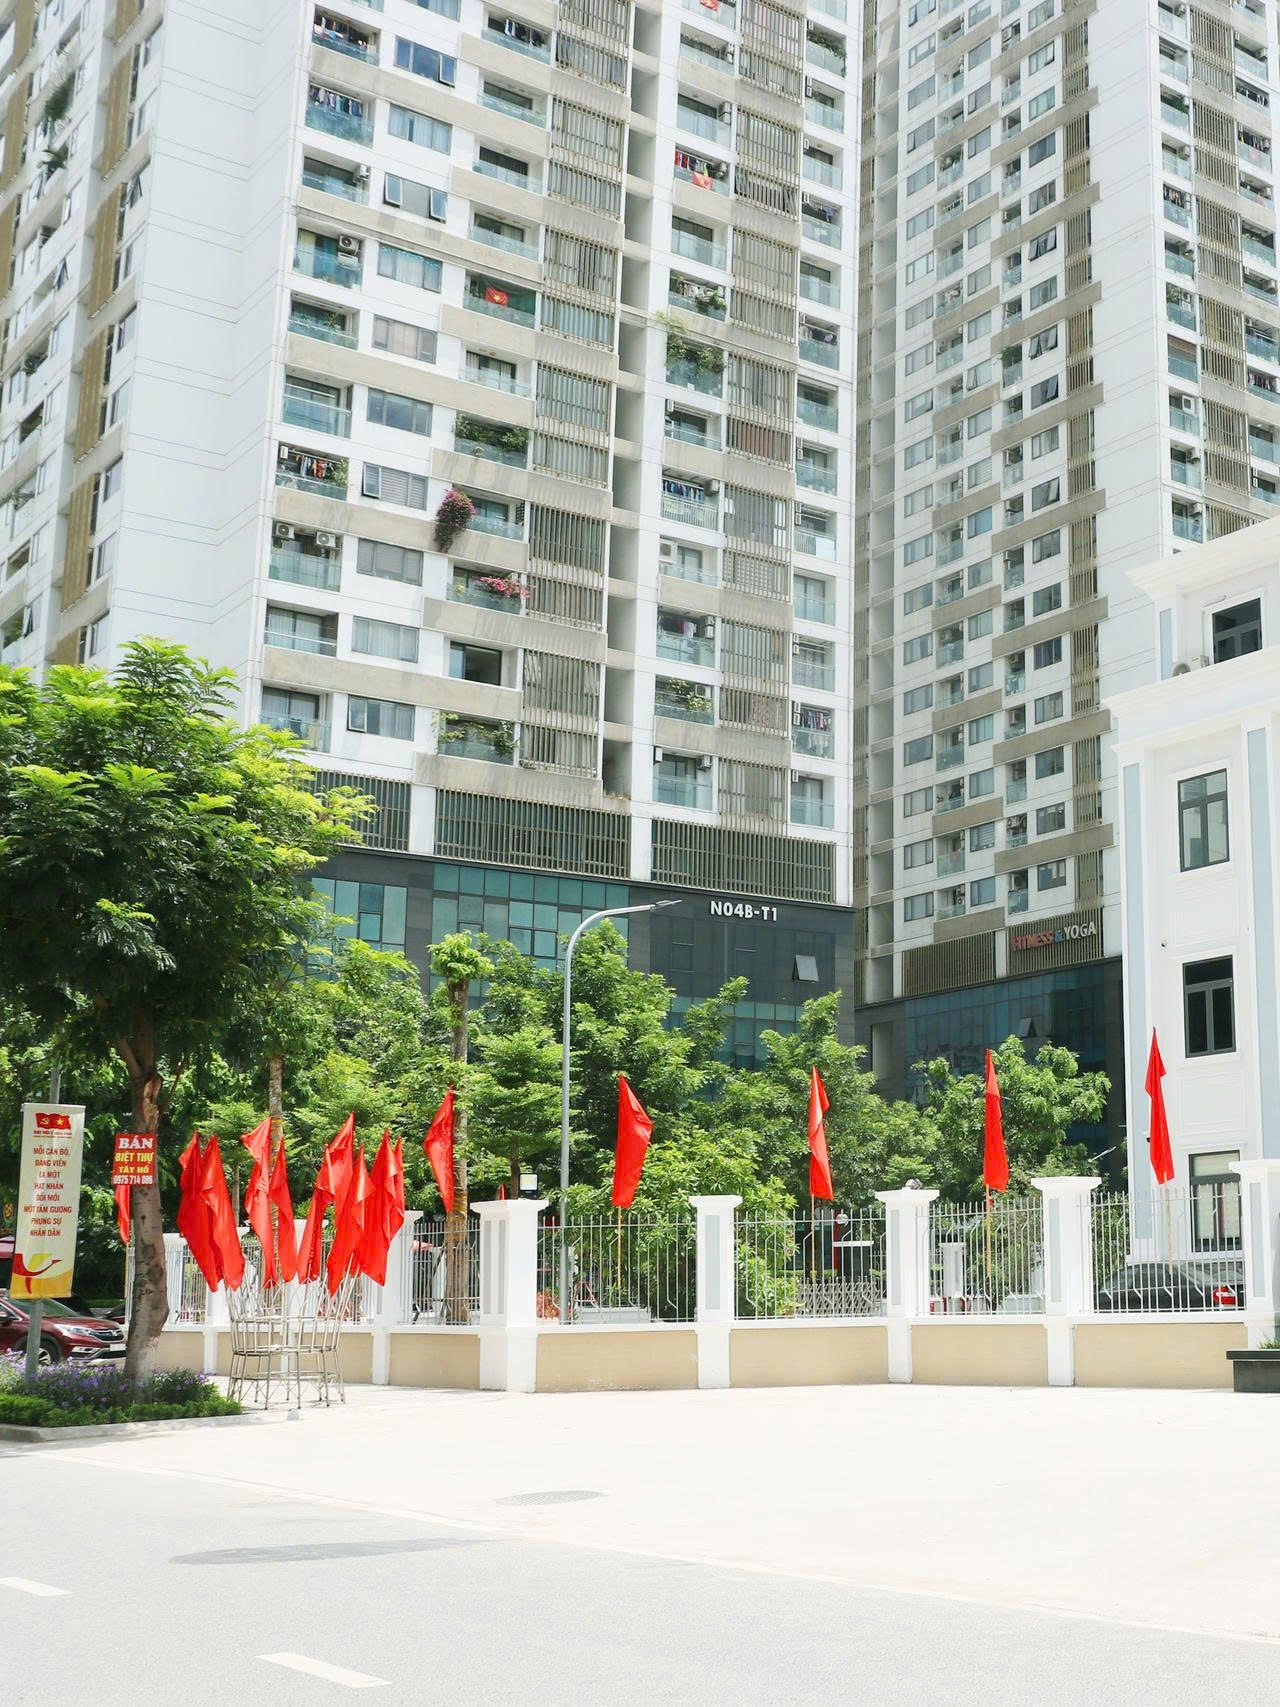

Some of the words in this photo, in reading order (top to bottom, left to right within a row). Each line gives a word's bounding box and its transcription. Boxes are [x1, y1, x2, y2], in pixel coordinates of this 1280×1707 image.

[1064, 921, 1096, 940] YOGA
[119, 1135, 153, 1149] BÁN
[116, 1151, 135, 1164] BIỆT
[137, 1152, 154, 1164] THỰ
[119, 1165, 134, 1173] TÂY
